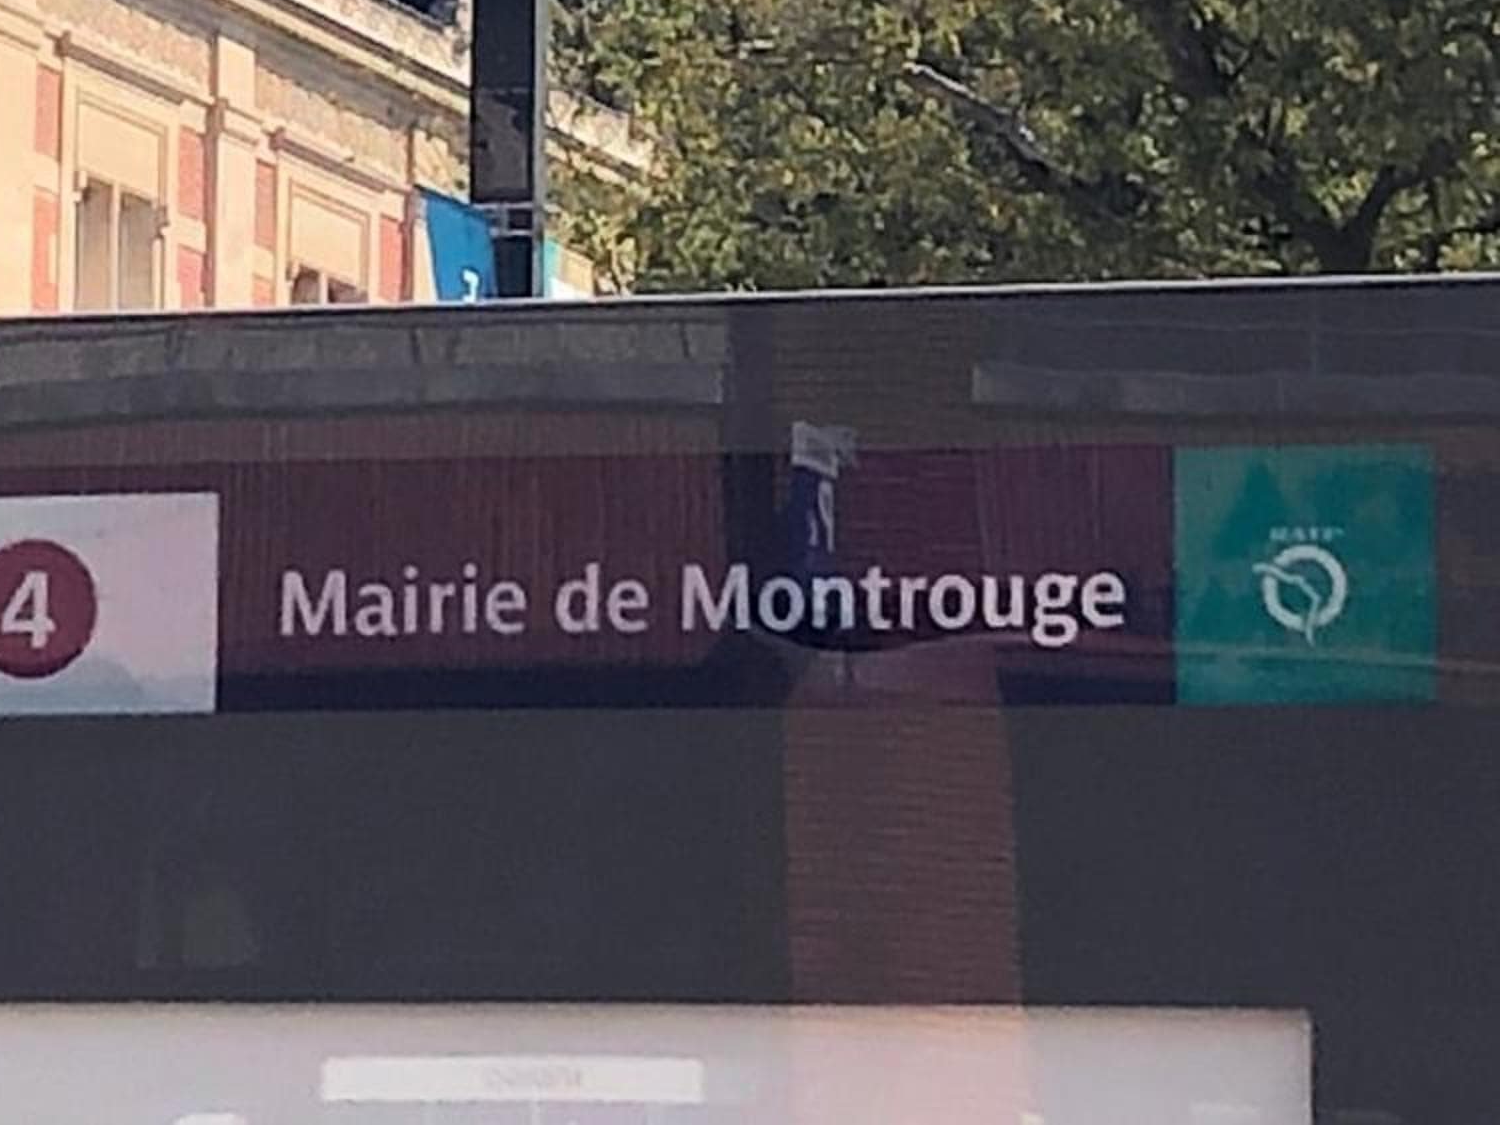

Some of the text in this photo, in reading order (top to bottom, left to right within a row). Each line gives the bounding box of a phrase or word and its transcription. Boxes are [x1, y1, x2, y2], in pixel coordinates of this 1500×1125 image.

[0, 571, 56, 648] 4
[280, 562, 1127, 647] Mairie de Montrouge
